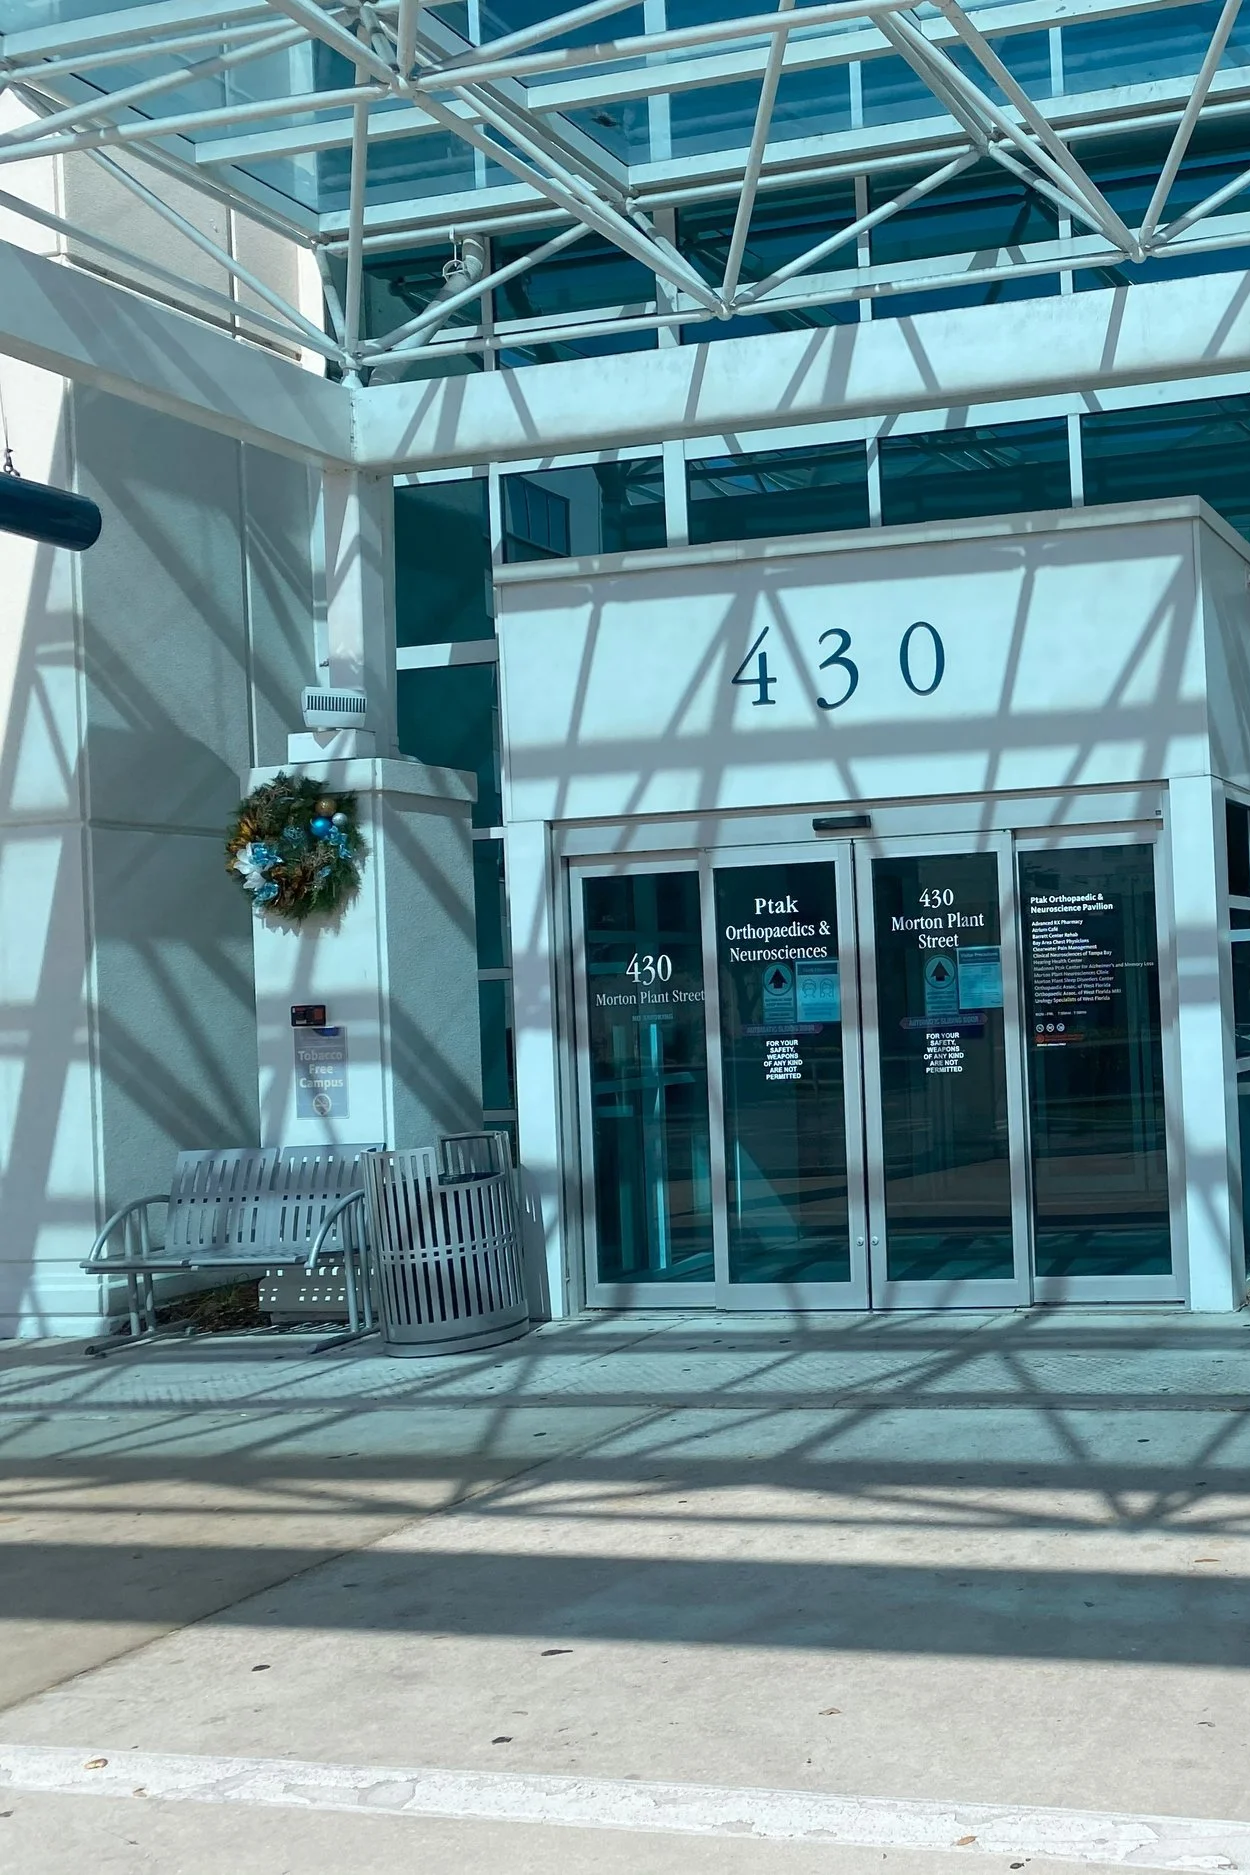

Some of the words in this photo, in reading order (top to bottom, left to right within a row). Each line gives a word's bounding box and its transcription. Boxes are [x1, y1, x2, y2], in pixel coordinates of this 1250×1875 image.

[731, 621, 945, 710] 430
[754, 895, 799, 915] Ptak
[919, 888, 954, 908] 430
[1030, 896, 1048, 904] Ptak
[1048, 893, 1096, 904] Orthopaedic
[1030, 904, 1082, 914] Neuroscience
[1082, 902, 1114, 911] Pavilion
[891, 916, 943, 931] Morton
[947, 912, 984, 928] Plant
[726, 921, 815, 942] Orthopaedics
[818, 920, 831, 936] &
[918, 934, 960, 949] Street
[730, 945, 828, 962] Neurosciences
[626, 953, 672, 986] 430
[596, 994, 637, 1006] Morton
[640, 990, 669, 1004] Plant
[672, 990, 705, 1002] Street
[298, 1050, 342, 1061] Tobacco
[308, 1064, 334, 1074] Free
[926, 1066, 963, 1074] PERMITTED
[300, 1078, 344, 1090] Campus
